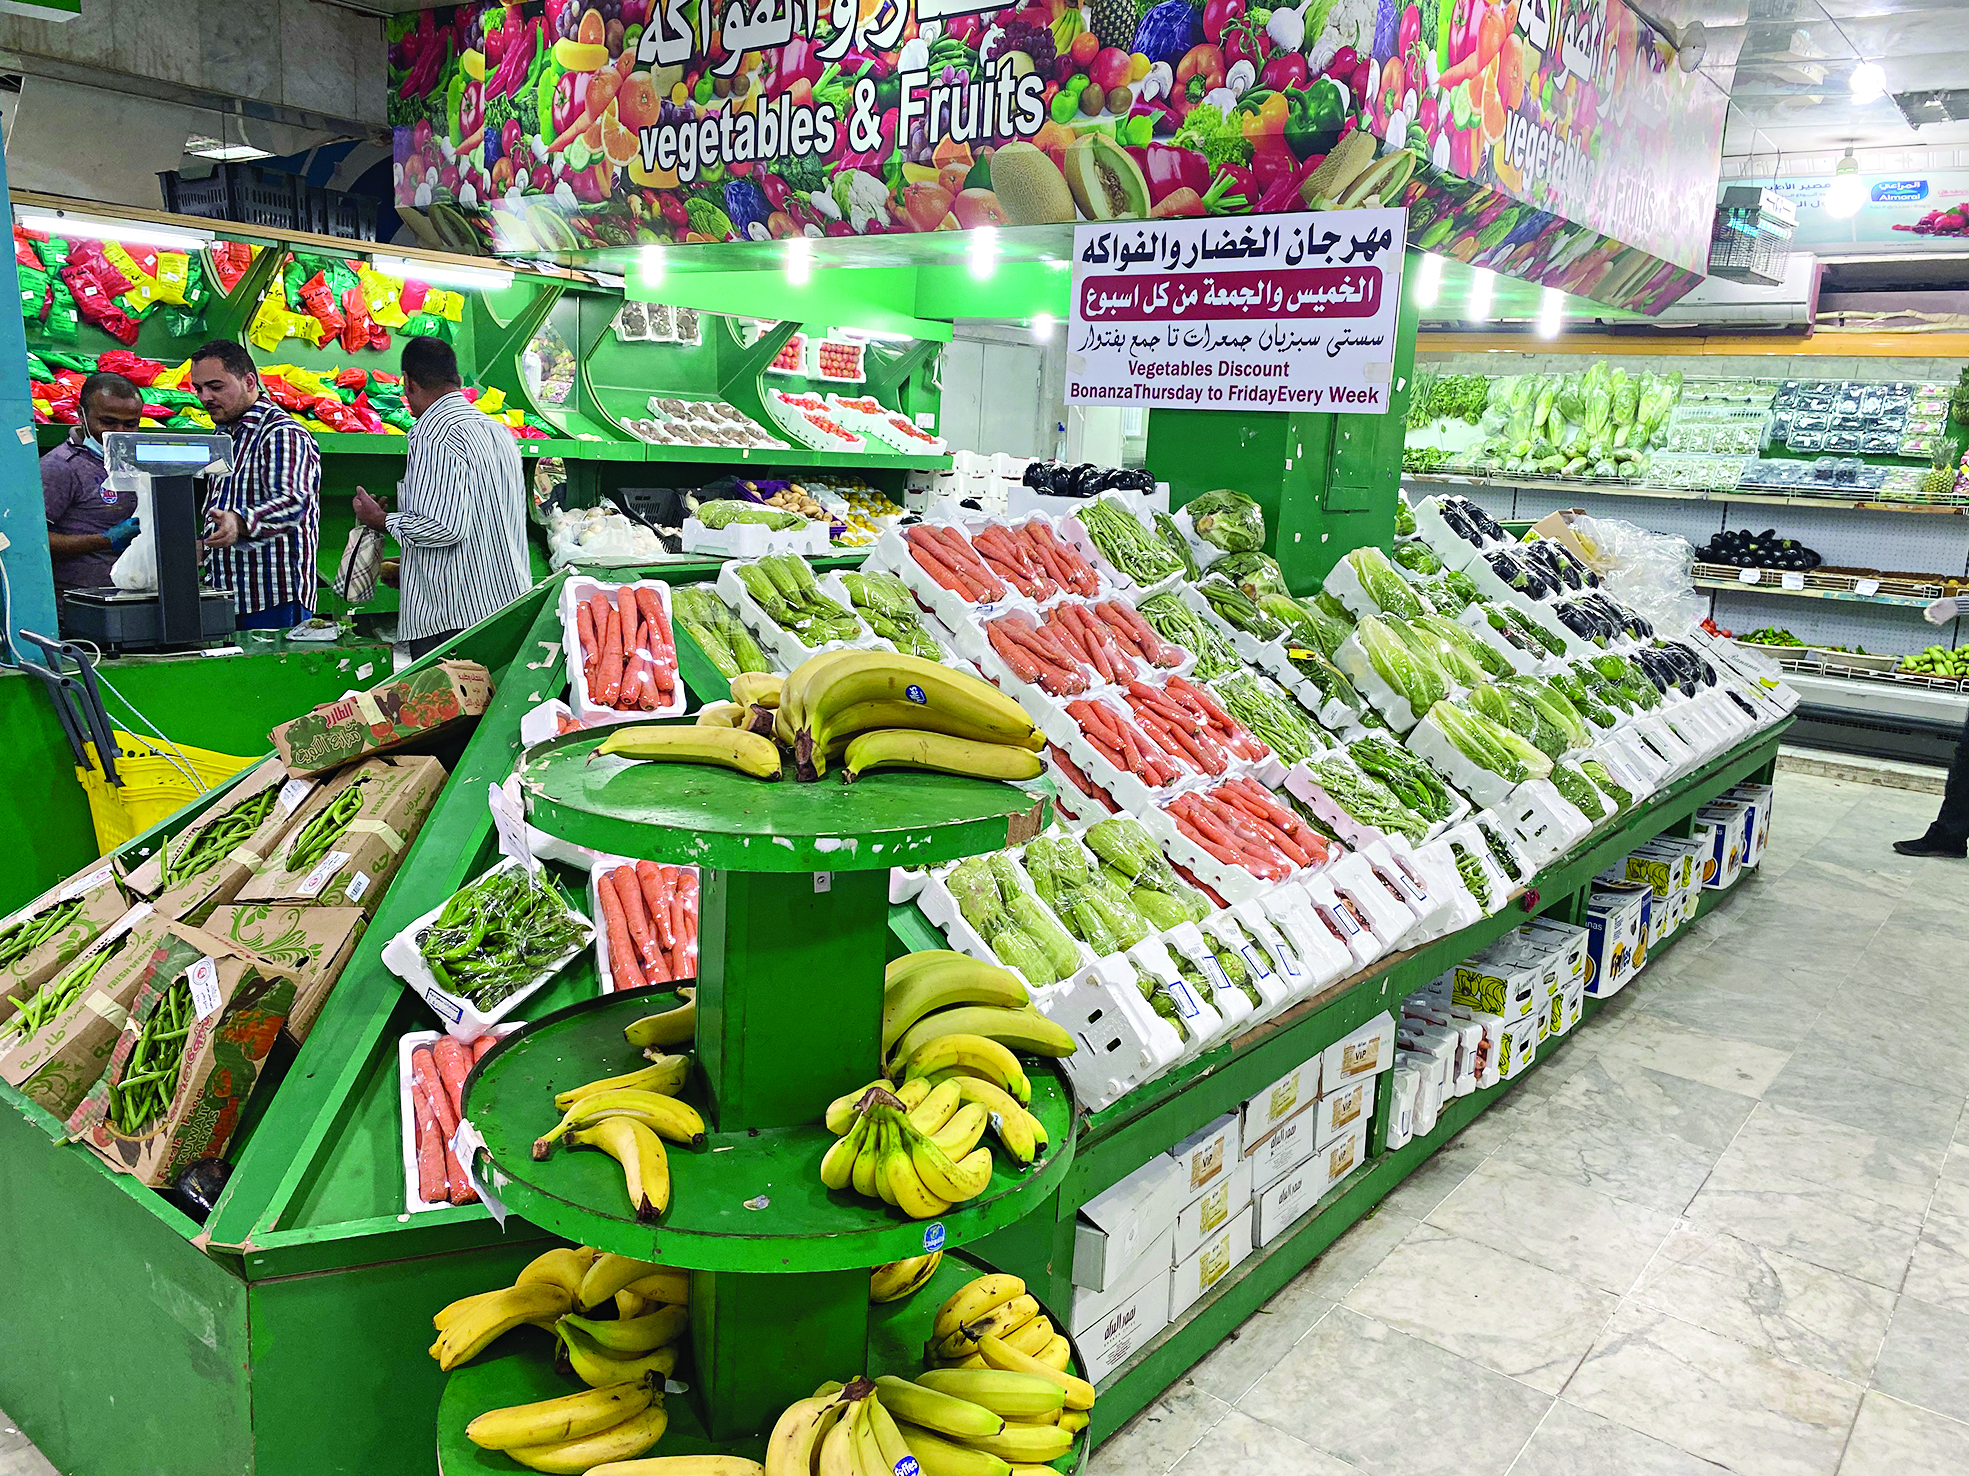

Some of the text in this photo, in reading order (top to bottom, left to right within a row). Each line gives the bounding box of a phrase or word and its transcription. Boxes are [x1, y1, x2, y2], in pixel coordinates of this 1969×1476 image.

[637, 60, 1049, 184] vegetables & Fruits
[1503, 105, 1596, 198] vegetables
[1082, 222, 1392, 271] مهرجان الخضار والفواكه
[1085, 275, 1374, 317] الخميس والجمعة من كل اسبوع
[1168, 323, 1180, 348] تا
[1183, 322, 1253, 352] جمعرات
[1128, 360, 1290, 378] Vegetables Discount
[1070, 382, 1380, 406] BonanzaThursday to FridayEvery Week
[1354, 1049, 1367, 1061] VIP
[1342, 1100, 1352, 1112] VIP
[176, 1103, 211, 1166] KUWAIT
[1202, 1153, 1213, 1167] VIP
